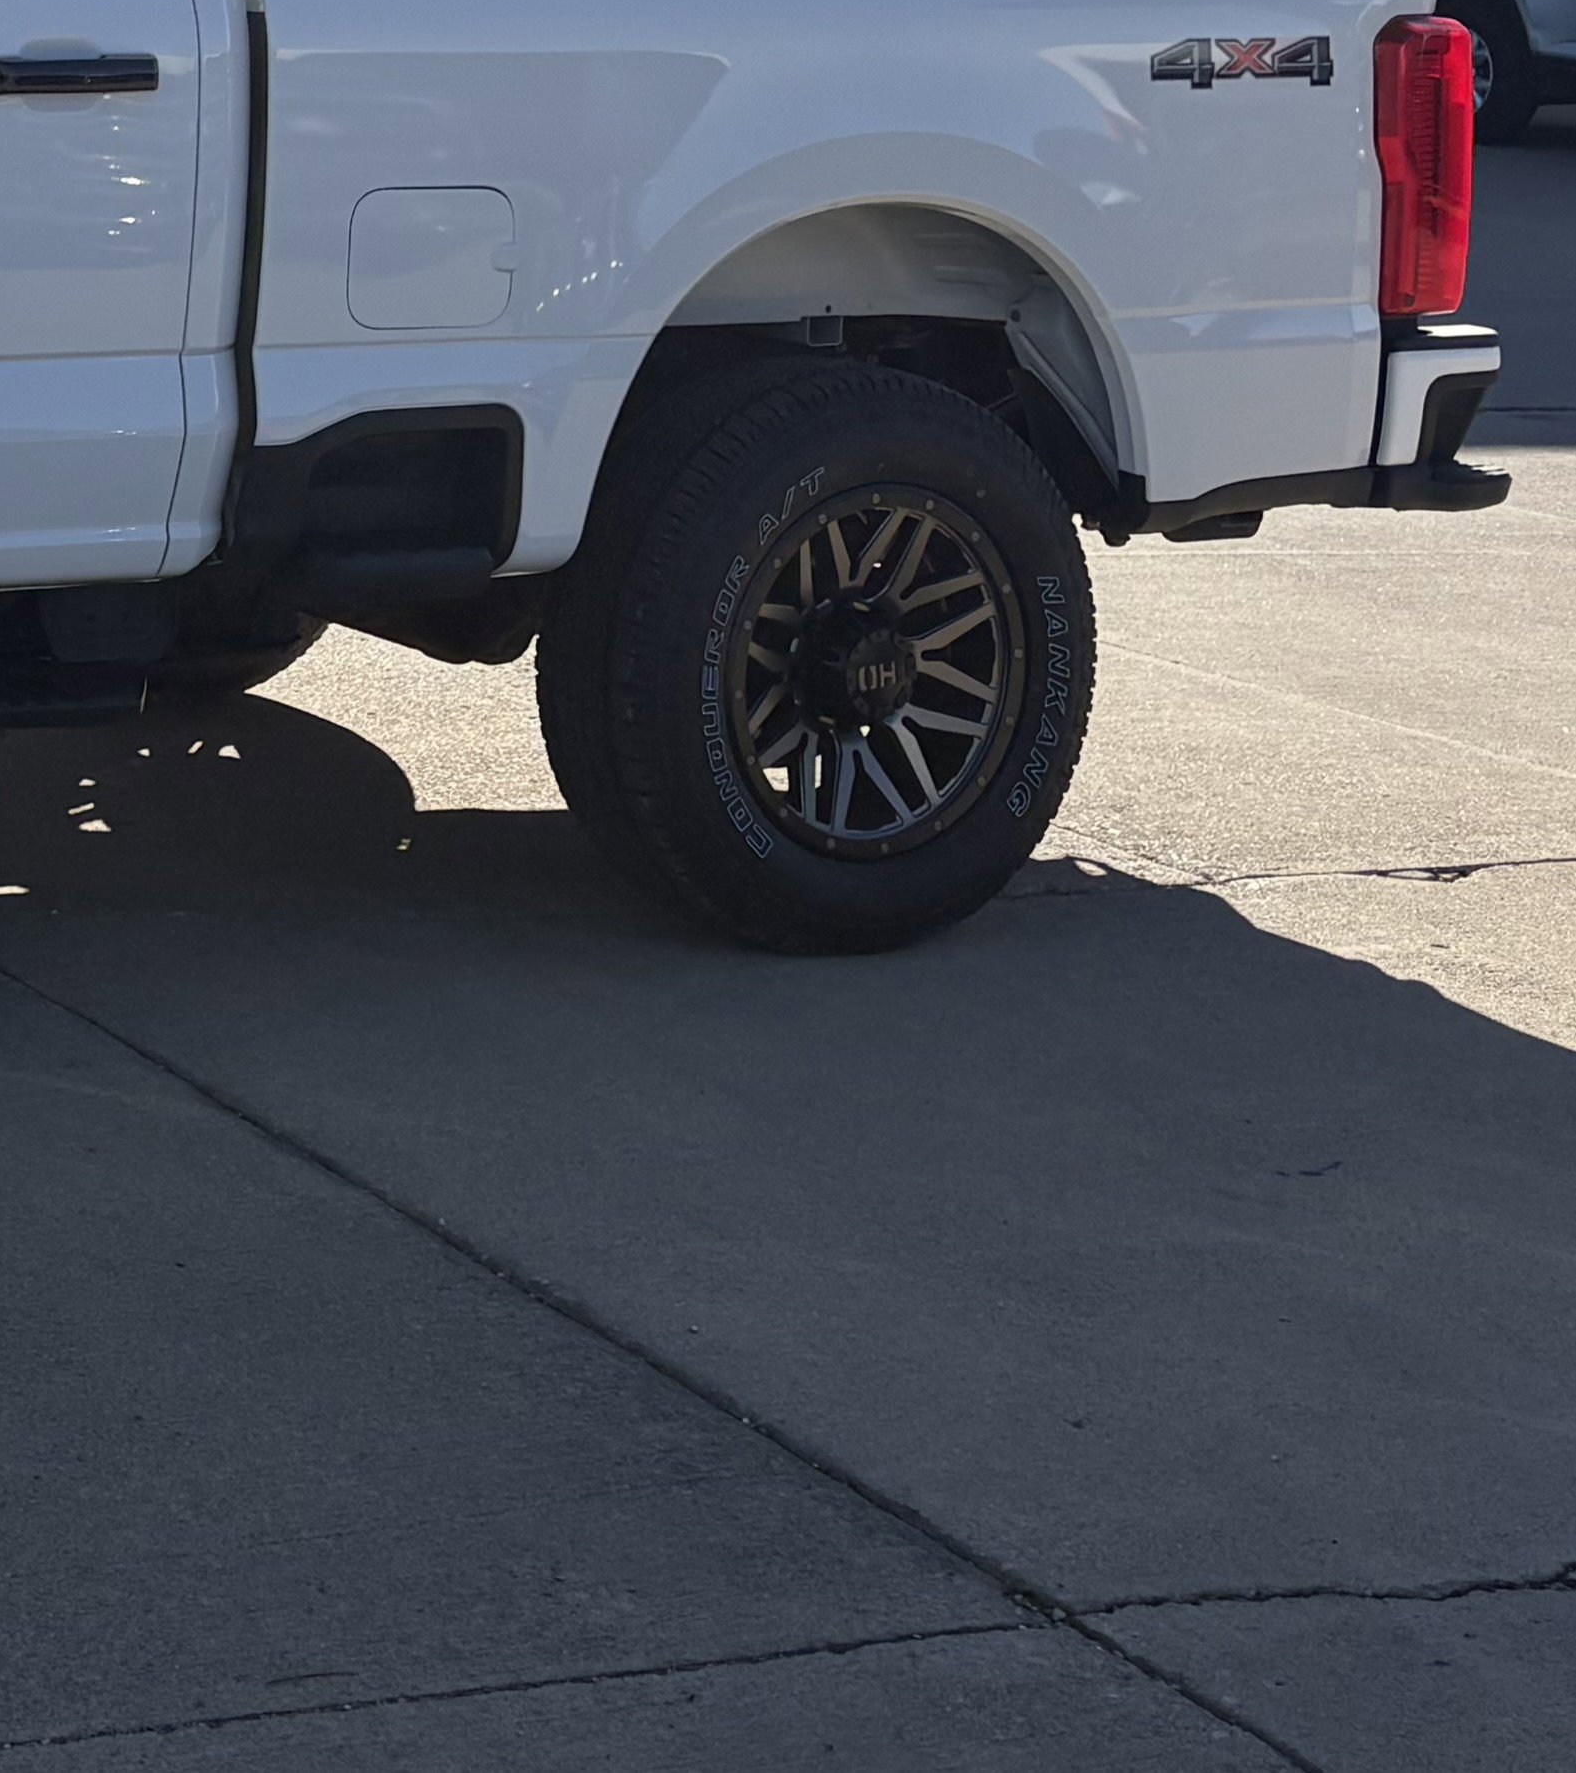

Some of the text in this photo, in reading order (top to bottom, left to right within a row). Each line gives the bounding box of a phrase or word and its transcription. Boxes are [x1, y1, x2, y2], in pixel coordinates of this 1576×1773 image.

[701, 467, 825, 859] CONQUEROR A/T
[1007, 576, 1071, 818] NANKANG
